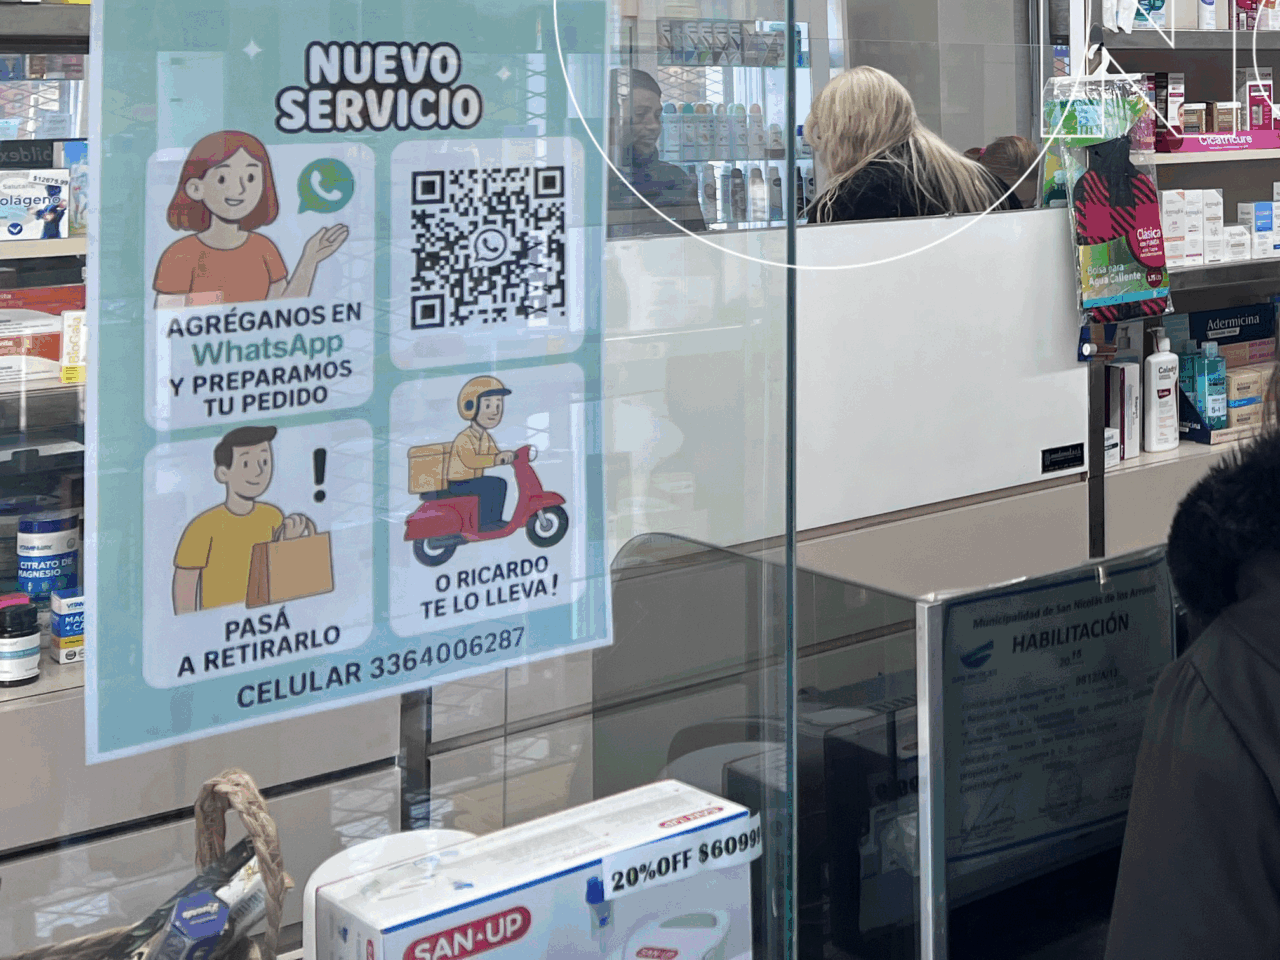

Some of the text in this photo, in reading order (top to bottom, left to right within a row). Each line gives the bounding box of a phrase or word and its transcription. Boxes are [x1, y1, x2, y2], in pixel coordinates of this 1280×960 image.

[304, 40, 462, 89] NUEVO
[274, 83, 483, 133] SERVICIO
[1198, 135, 1253, 145] Cicatricure
[1136, 226, 1161, 241] Clásica
[1087, 265, 1107, 275] Bolsa
[1089, 271, 1141, 287] Agua Caliente
[167, 301, 362, 339] AGRÉGANOS EN
[1206, 313, 1260, 331] Adermicina
[191, 333, 344, 368] WhatsApp
[169, 359, 353, 397] Y PREPARAMOS
[203, 385, 328, 418] TU PEDIDO
[18, 568, 61, 578] MAGNESIO
[20, 556, 73, 569] CITRATO DE
[435, 555, 549, 593] O RICARDO
[224, 605, 291, 642] PASÁ
[421, 598, 447, 620] TE
[452, 592, 479, 614] LO
[973, 608, 1041, 629] Municipalidad
[1056, 602, 1072, 614] San
[1012, 611, 1130, 654] HABILITACIÓN
[177, 623, 341, 678] A RETIRARLO
[236, 626, 526, 709] CELULAR 3364006287
[611, 848, 693, 892] 20%OFF
